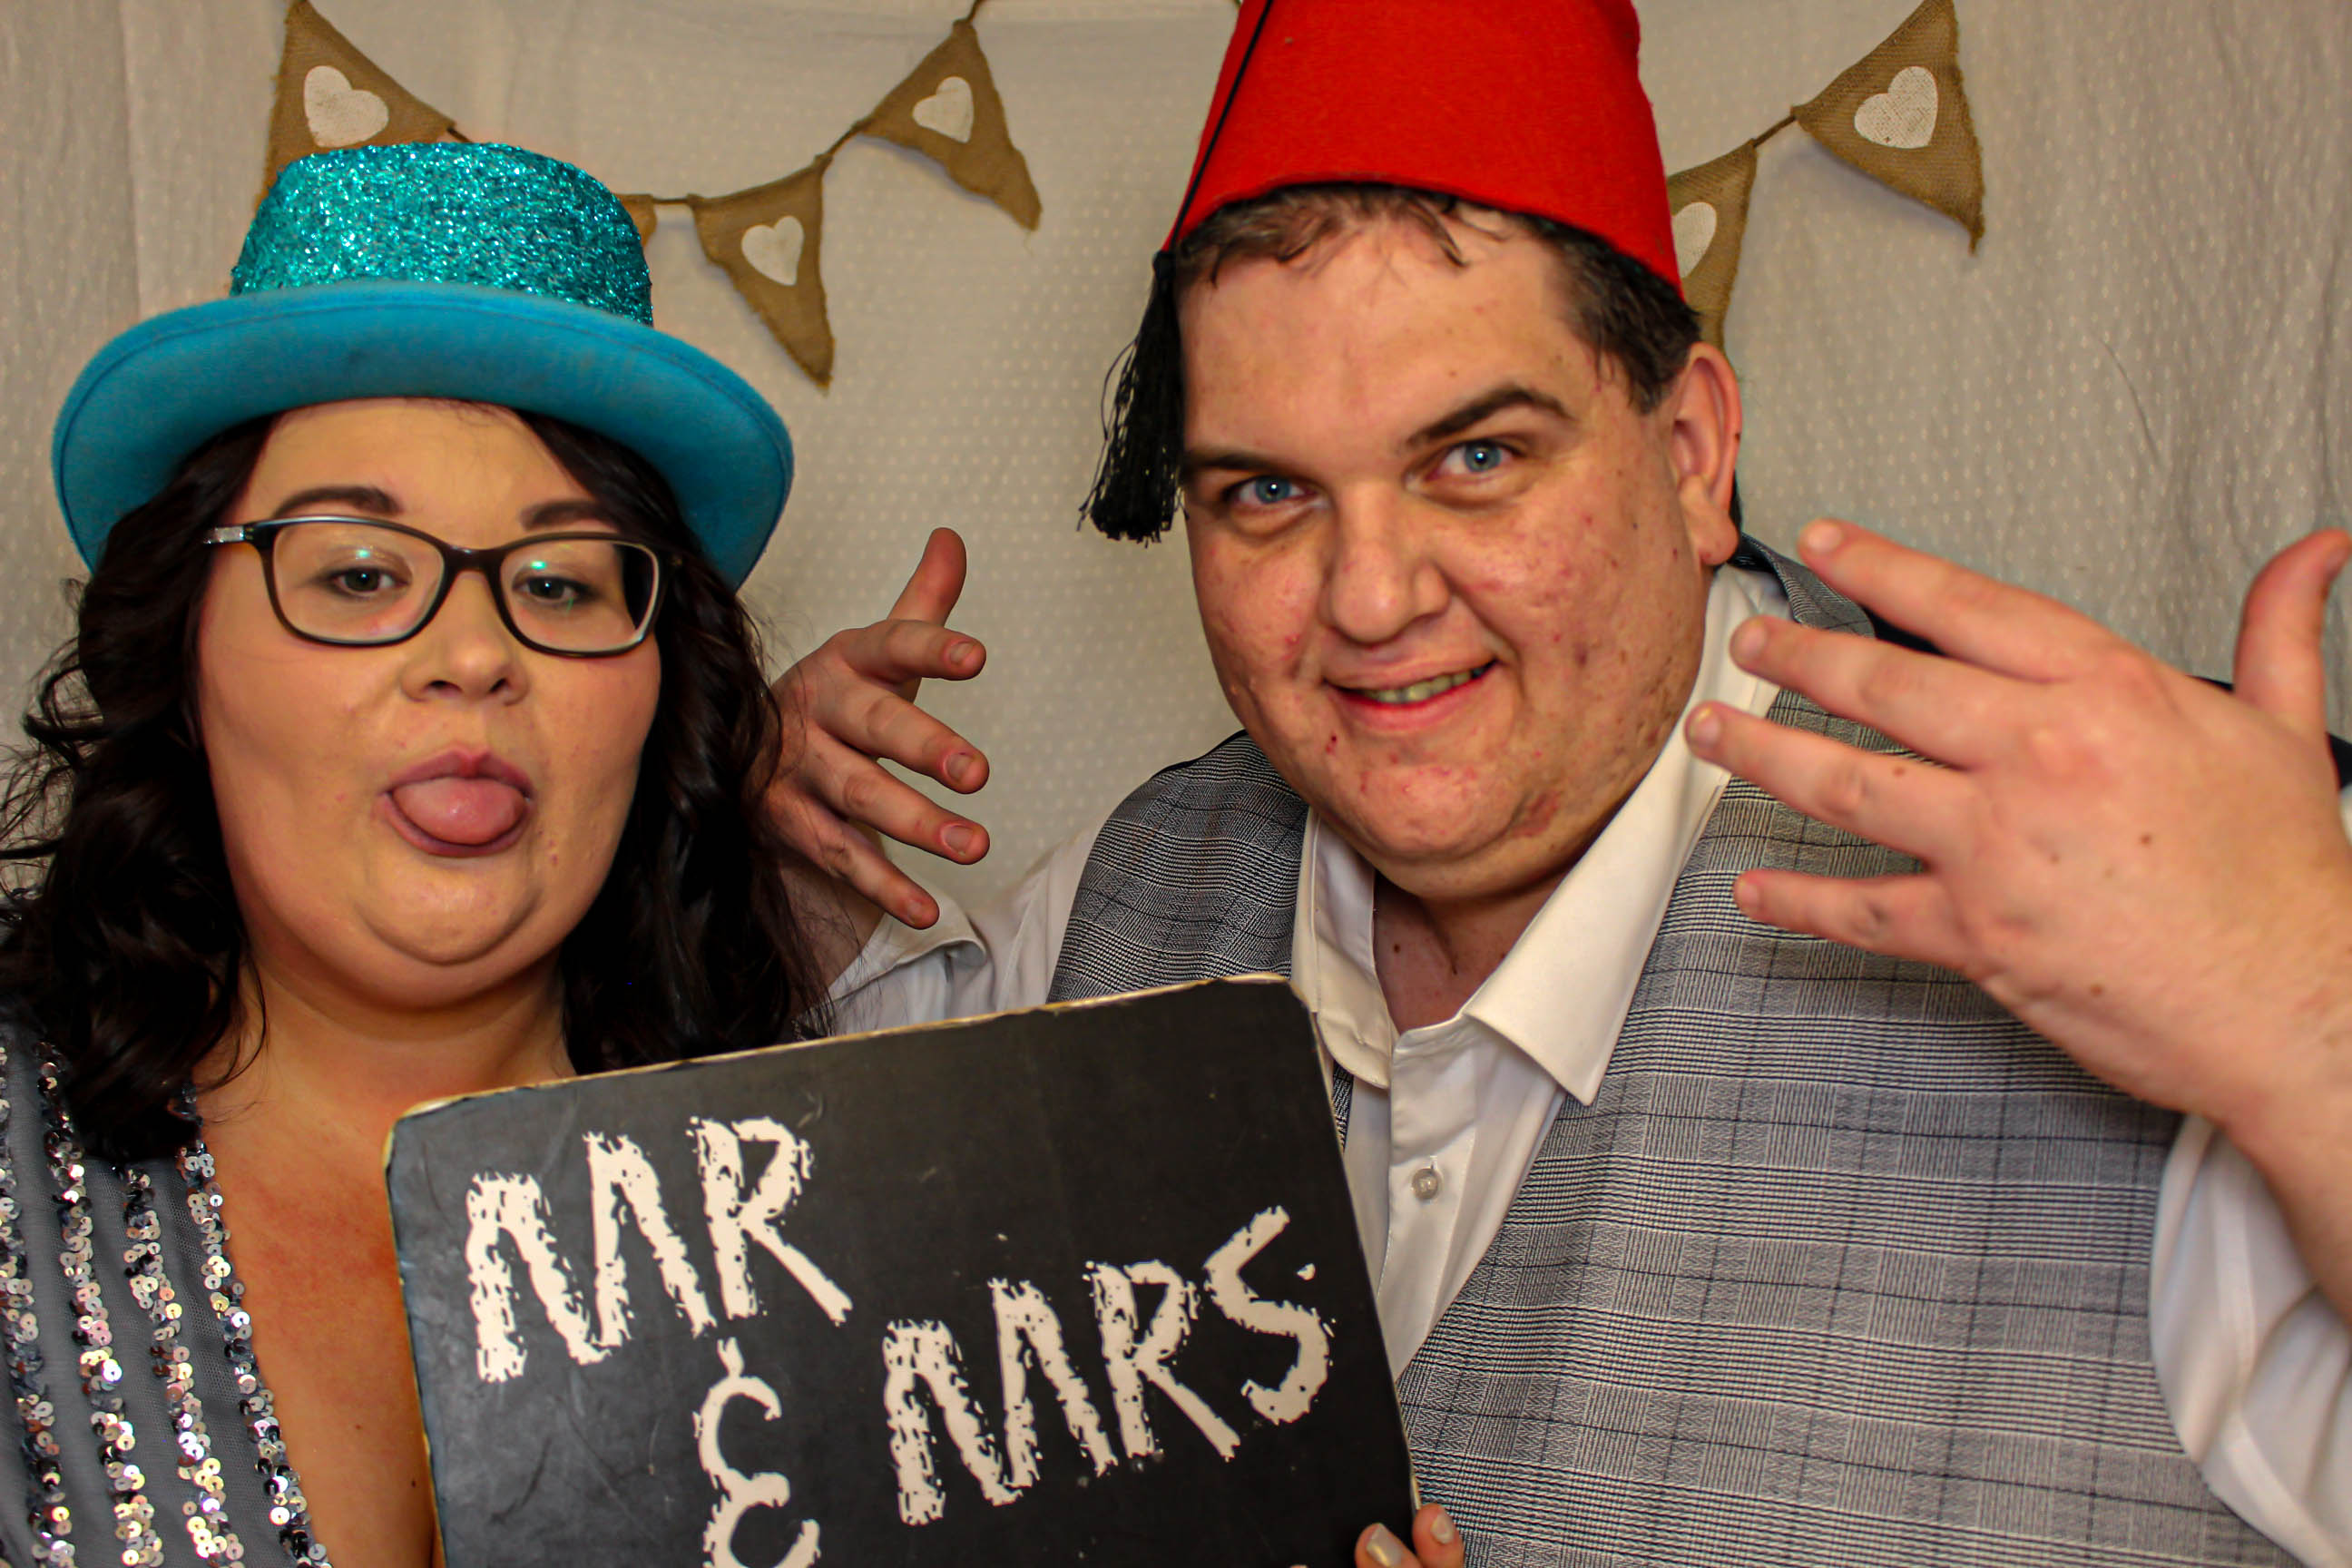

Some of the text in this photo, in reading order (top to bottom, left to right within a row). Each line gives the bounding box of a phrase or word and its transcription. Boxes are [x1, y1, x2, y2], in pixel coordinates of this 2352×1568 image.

[465, 1116, 852, 1384] MR
[884, 1206, 1335, 1524] MRS
[693, 1338, 821, 1568] &
